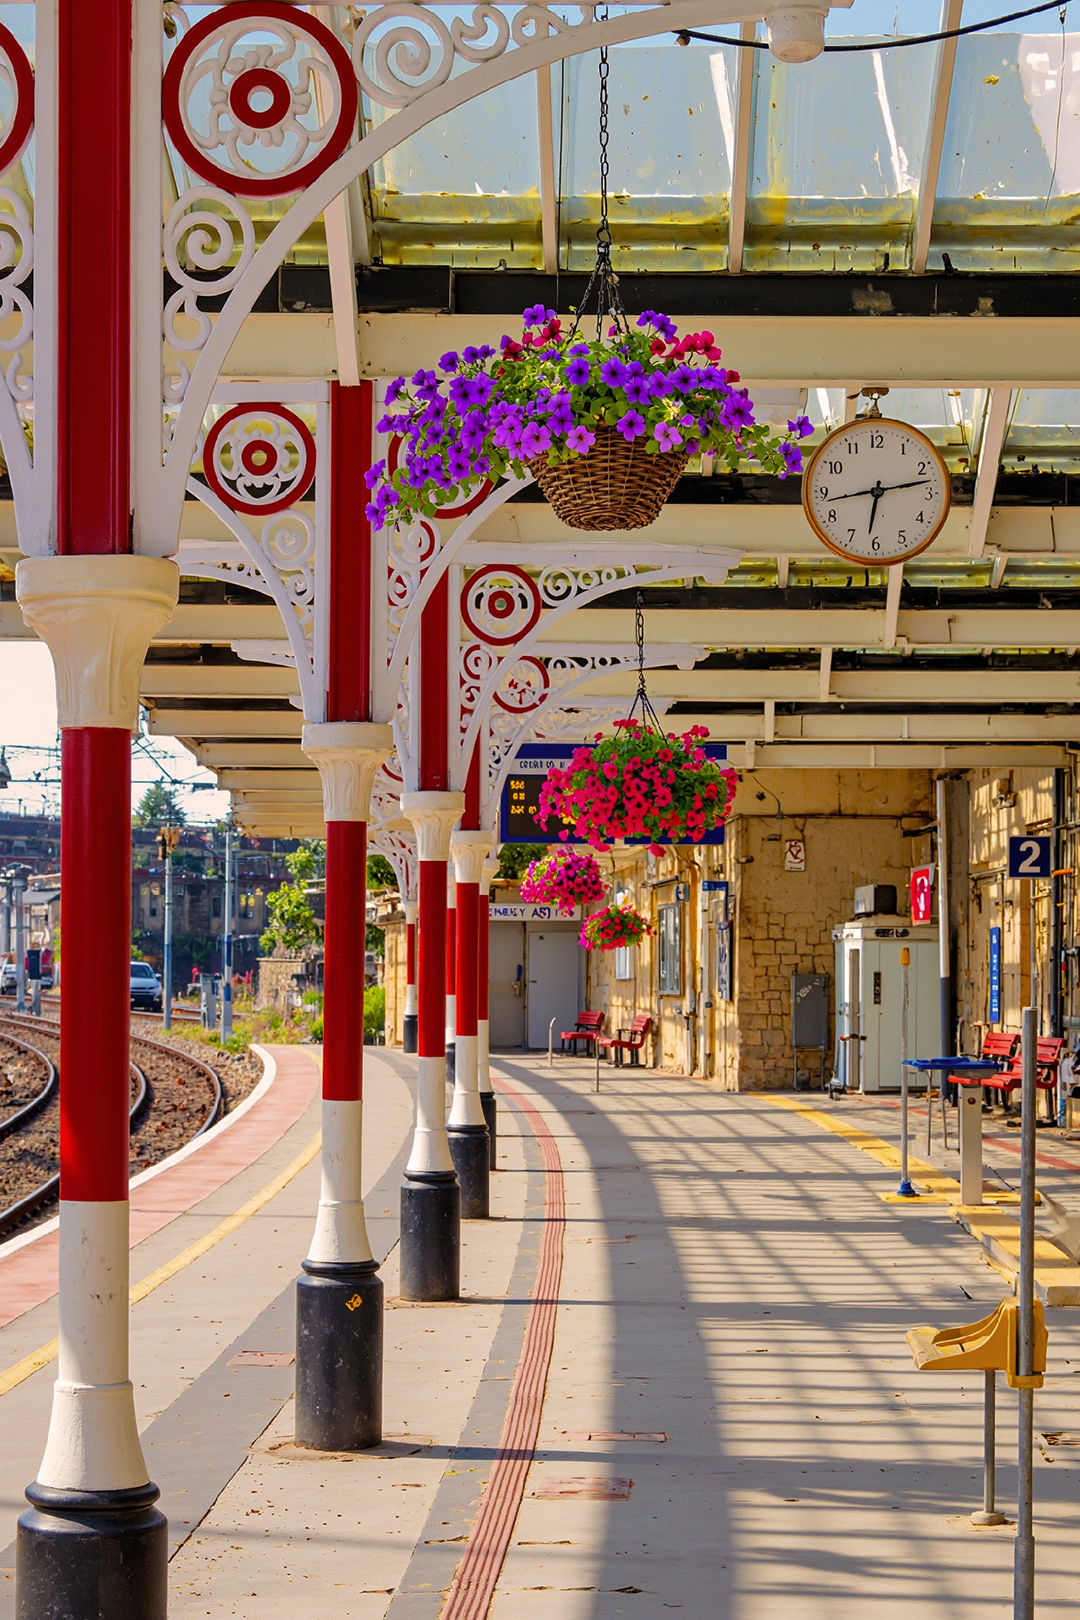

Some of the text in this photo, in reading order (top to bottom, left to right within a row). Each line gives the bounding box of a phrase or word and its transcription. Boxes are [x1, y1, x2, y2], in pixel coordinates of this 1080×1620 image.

[848, 442, 858, 454] 11
[870, 434, 884, 448] 12
[901, 443, 906, 455] 1
[828, 461, 843, 474] 10
[917, 462, 926, 475] 2
[820, 486, 829, 500] 9
[925, 487, 933, 501] 3
[828, 509, 837, 523] 8
[915, 511, 924, 523] 4
[847, 529, 856, 543] 7
[898, 530, 906, 544] 5
[871, 536, 880, 551] 6
[1018, 840, 1041, 873] 2
